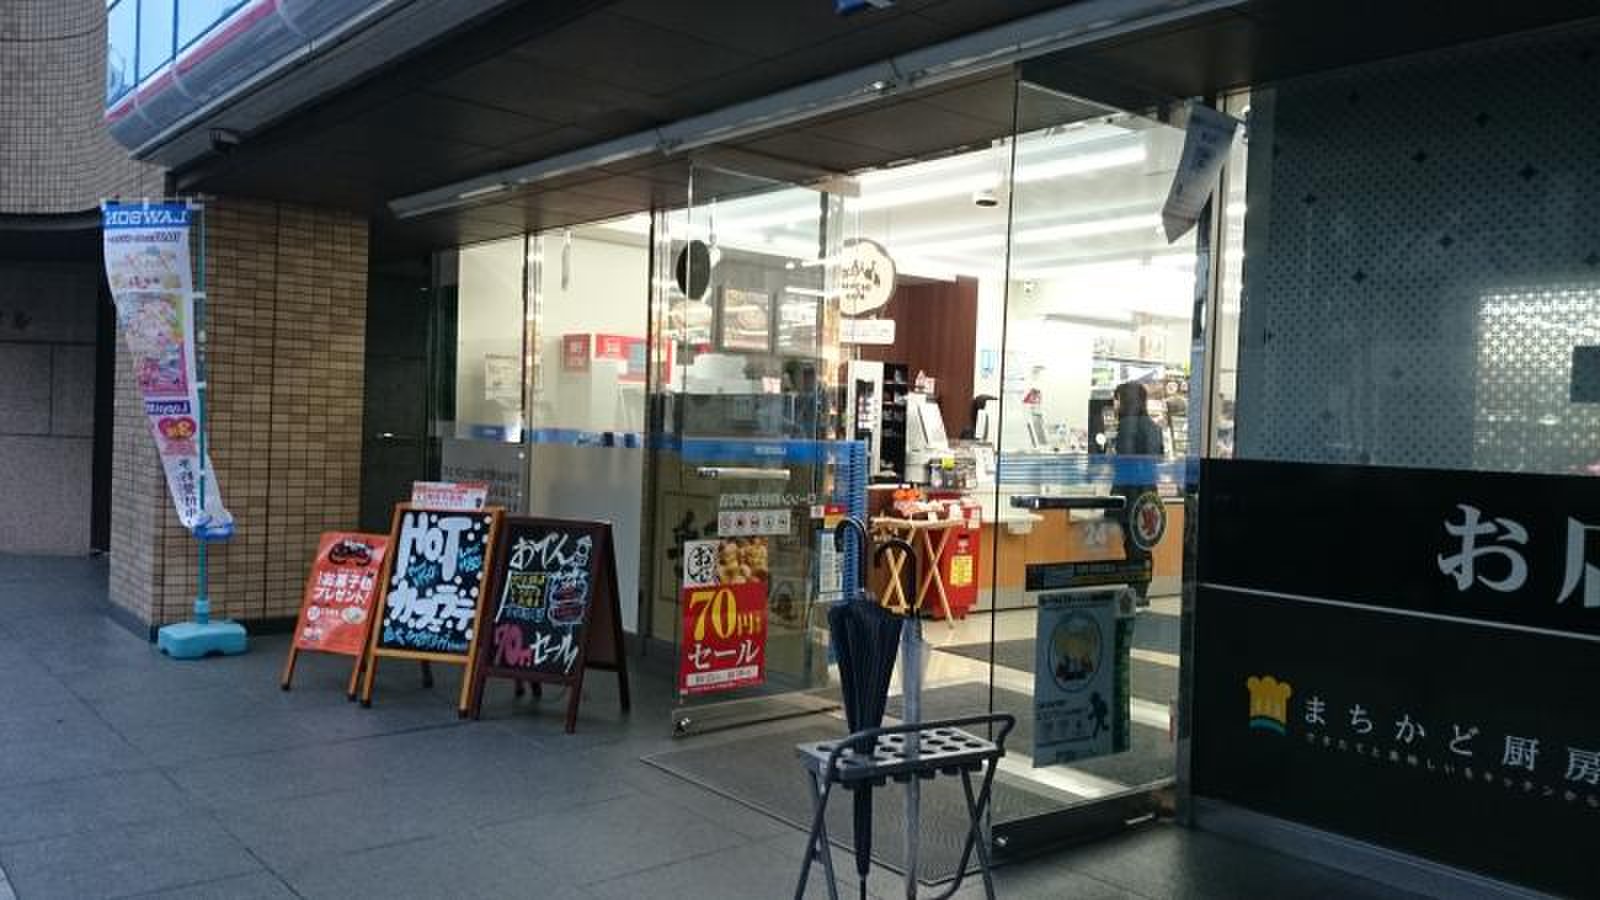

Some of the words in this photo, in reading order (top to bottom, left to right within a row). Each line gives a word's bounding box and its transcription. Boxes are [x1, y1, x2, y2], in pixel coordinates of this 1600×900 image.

[399, 512, 472, 580] HOT
[508, 532, 576, 570] おでん
[528, 631, 579, 674] セール
[687, 640, 760, 671] セール
[1304, 696, 1600, 786] まちかど厨房
